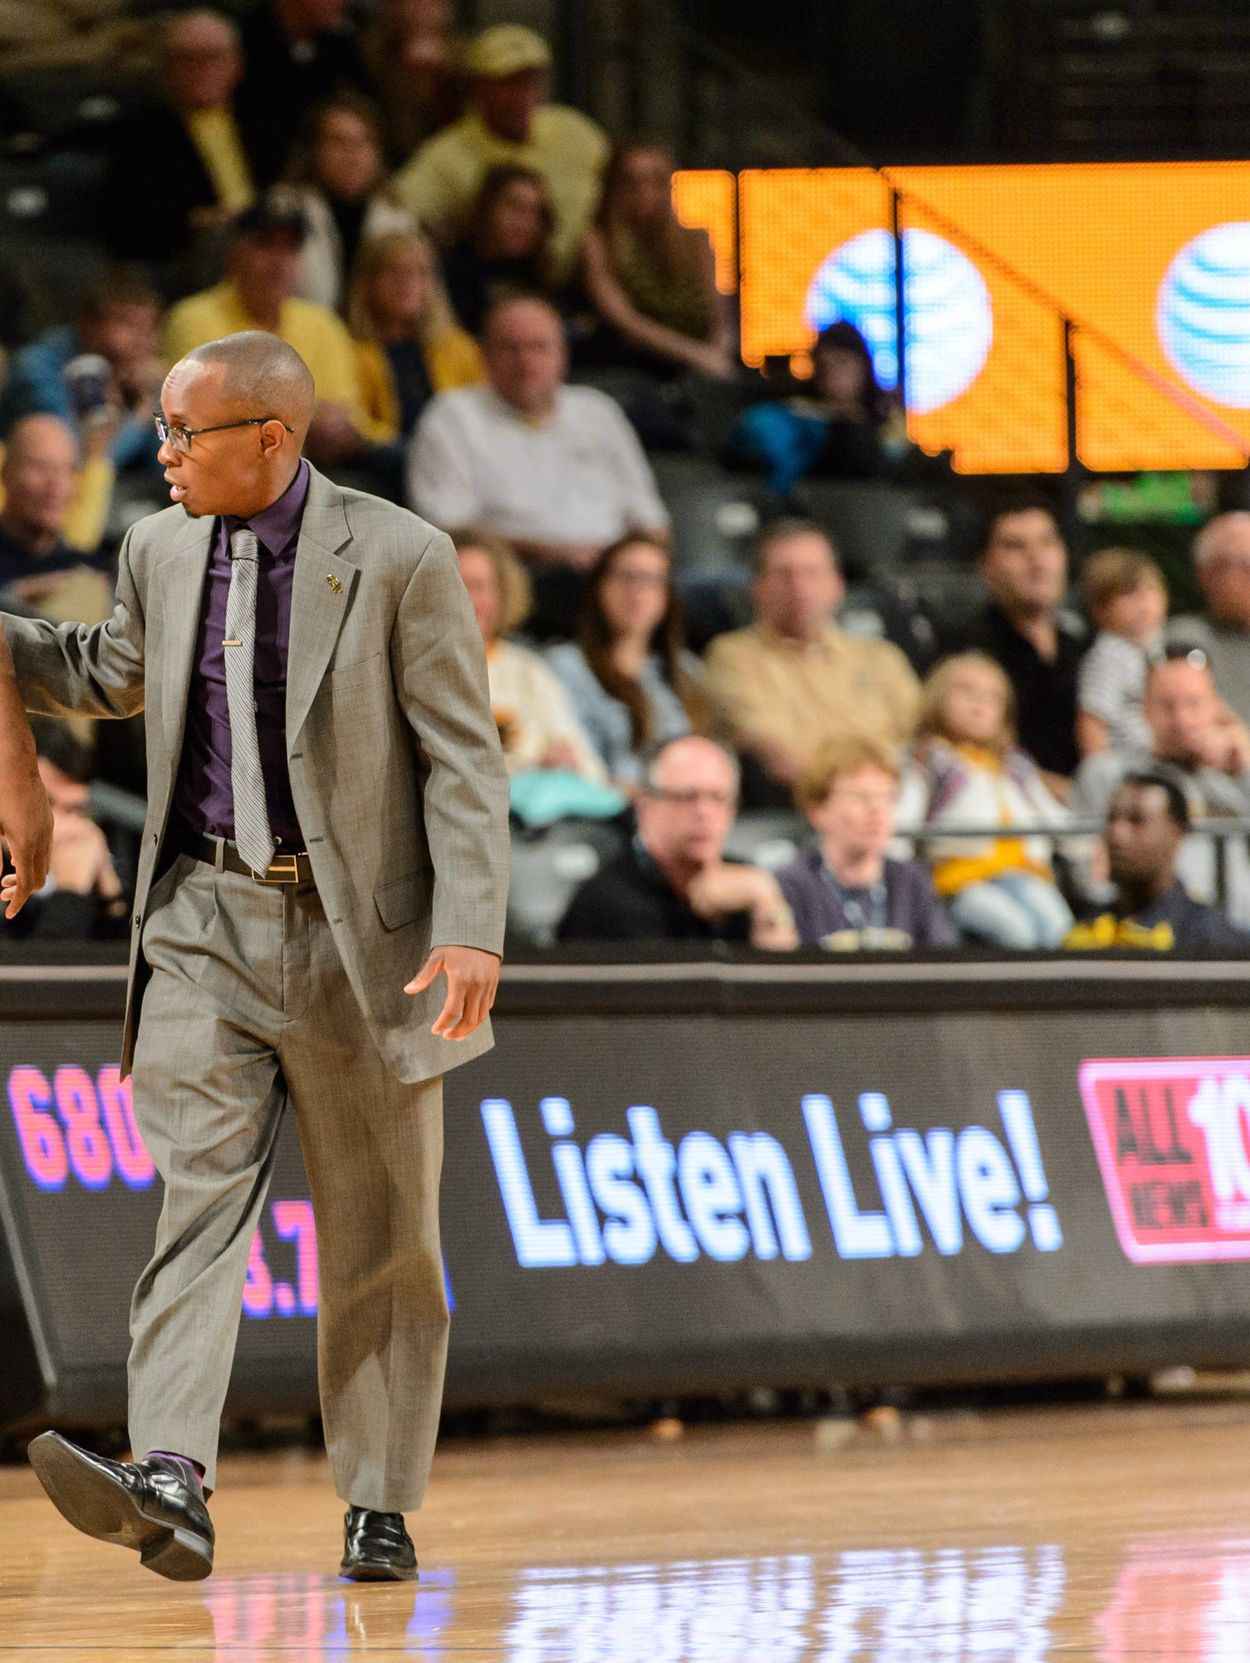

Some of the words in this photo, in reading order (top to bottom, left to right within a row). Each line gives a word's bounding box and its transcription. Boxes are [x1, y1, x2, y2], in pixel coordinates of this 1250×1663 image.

[7, 1064, 156, 1192] 680
[480, 1097, 812, 1268] Listen
[801, 1089, 1063, 1260] Live!
[1115, 1086, 1193, 1166] ALL
